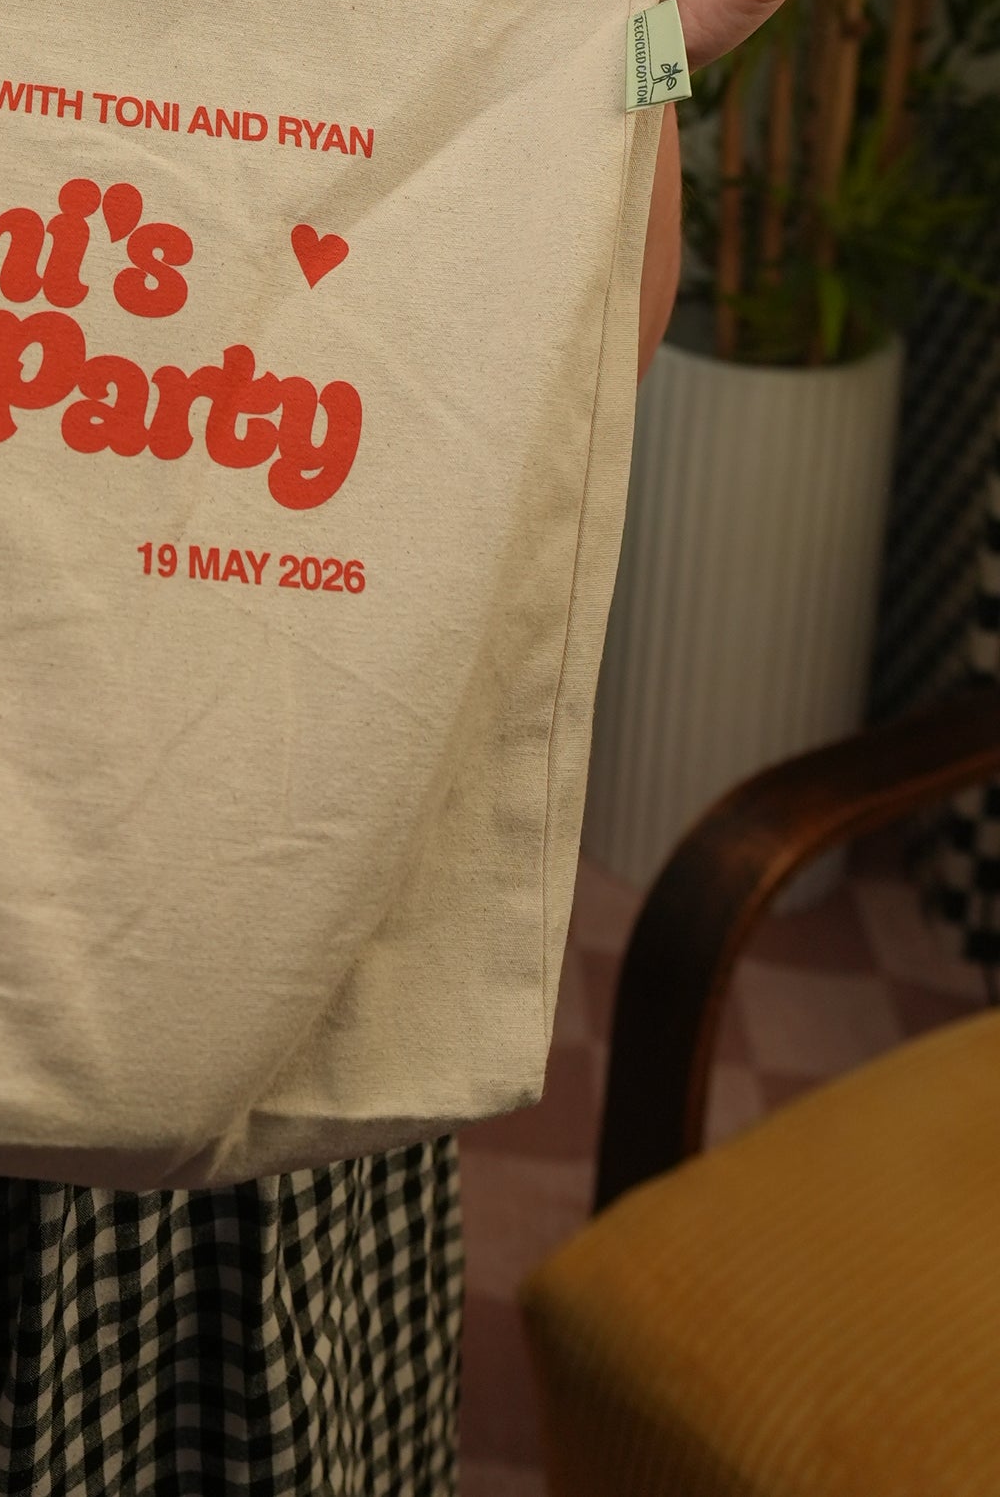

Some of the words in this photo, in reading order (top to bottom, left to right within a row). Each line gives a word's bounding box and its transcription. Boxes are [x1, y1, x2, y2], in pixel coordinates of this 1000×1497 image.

[634, 16, 646, 63] RECYCLED
[636, 65, 648, 104] COTTON
[93, 92, 180, 132] TONI
[187, 105, 269, 142] AND
[278, 115, 375, 158] RYAN
[137, 541, 178, 578] 19
[188, 545, 271, 585] MAY
[279, 554, 366, 594] 2026
